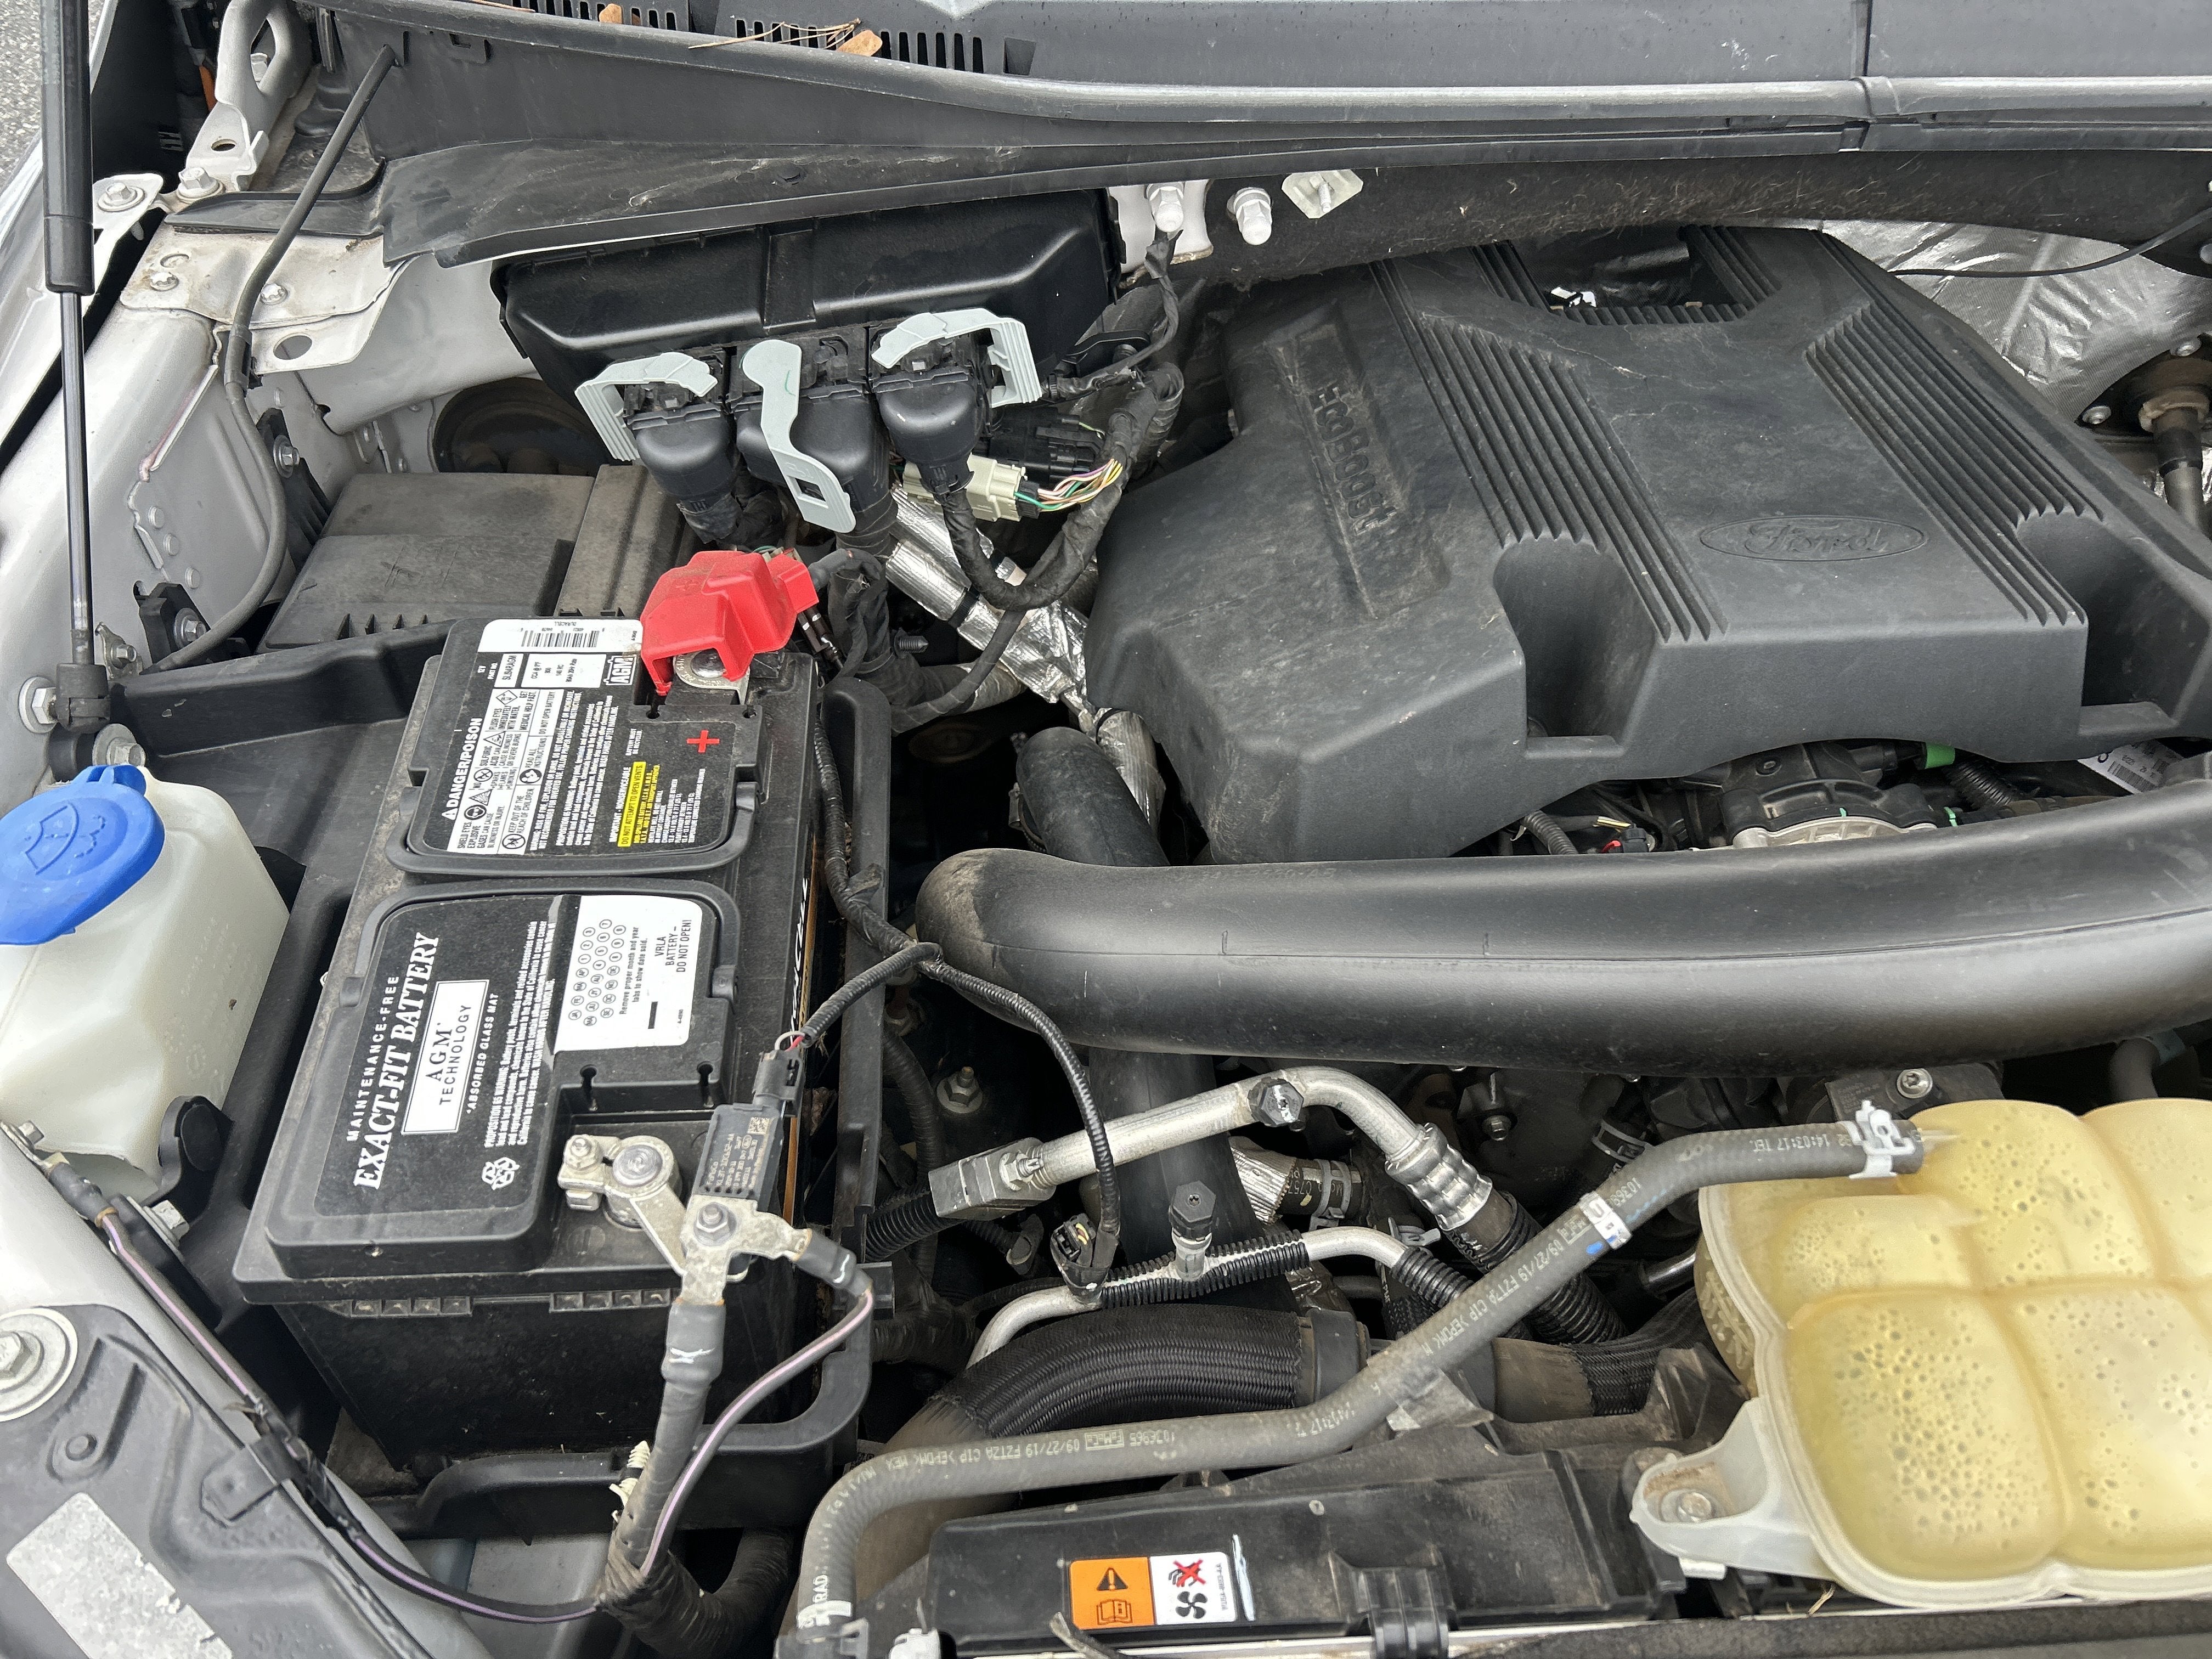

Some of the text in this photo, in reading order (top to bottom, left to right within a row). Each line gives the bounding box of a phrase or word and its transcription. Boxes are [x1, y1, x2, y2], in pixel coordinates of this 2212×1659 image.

[1309, 385, 1397, 536] ECOBOOST
[1745, 523, 1889, 556] Ford
[487, 669, 496, 679] PART
[610, 657, 634, 682] AGM
[524, 703, 533, 712] HELP
[542, 708, 551, 718] OPEN
[489, 708, 502, 729] FLUSH EYES
[507, 720, 516, 729] WITH
[519, 713, 531, 730] MEDICAL
[448, 718, 483, 807] DANGER/POISON
[479, 746, 493, 765] SULFURIC
[489, 756, 499, 765] ACID
[498, 754, 507, 765] CAUSE
[508, 747, 518, 759] SEVERE
[524, 757, 534, 768] READ
[625, 803, 635, 824] ATTEMPT
[631, 782, 639, 794] OPEN
[510, 812, 520, 820] OUT
[476, 834, 488, 848] GASES
[484, 813, 494, 824] CAUSE
[507, 822, 517, 832] KEEP
[516, 819, 527, 833] REACH
[609, 812, 622, 842] IMPORTANT
[456, 833, 469, 848] SHIELD
[467, 825, 481, 848] EXPLOSIVE
[639, 938, 648, 951] sold.
[654, 936, 667, 956] VRLA
[664, 933, 678, 965] BATTERY
[675, 919, 692, 972] DO NOT OPEN!
[520, 940, 534, 969] accessories
[637, 954, 645, 965] date
[515, 970, 528, 989] related
[619, 927, 640, 1013] Remove proper month and year
[635, 967, 644, 981] show
[514, 990, 524, 999] and
[632, 991, 640, 1001] tabs
[478, 1017, 494, 1049] GLASS
[486, 993, 499, 1012] MAT
[508, 1000, 522, 1025] terminals
[345, 976, 399, 1141] MAINTENANCE-FREE
[352, 932, 440, 1189] EXACT-FIT BATTERY
[439, 1005, 472, 1104] TECHNOLOGY
[500, 1045, 515, 1065] Battery
[531, 1049, 543, 1067] WASH
[483, 1105, 502, 1147] PROPOSITION
[1469, 1299, 1488, 1322] CIP
[960, 1448, 981, 1464] CIP
[1026, 1438, 1080, 1458] 09/27/19
[885, 1454, 909, 1471] MEX
